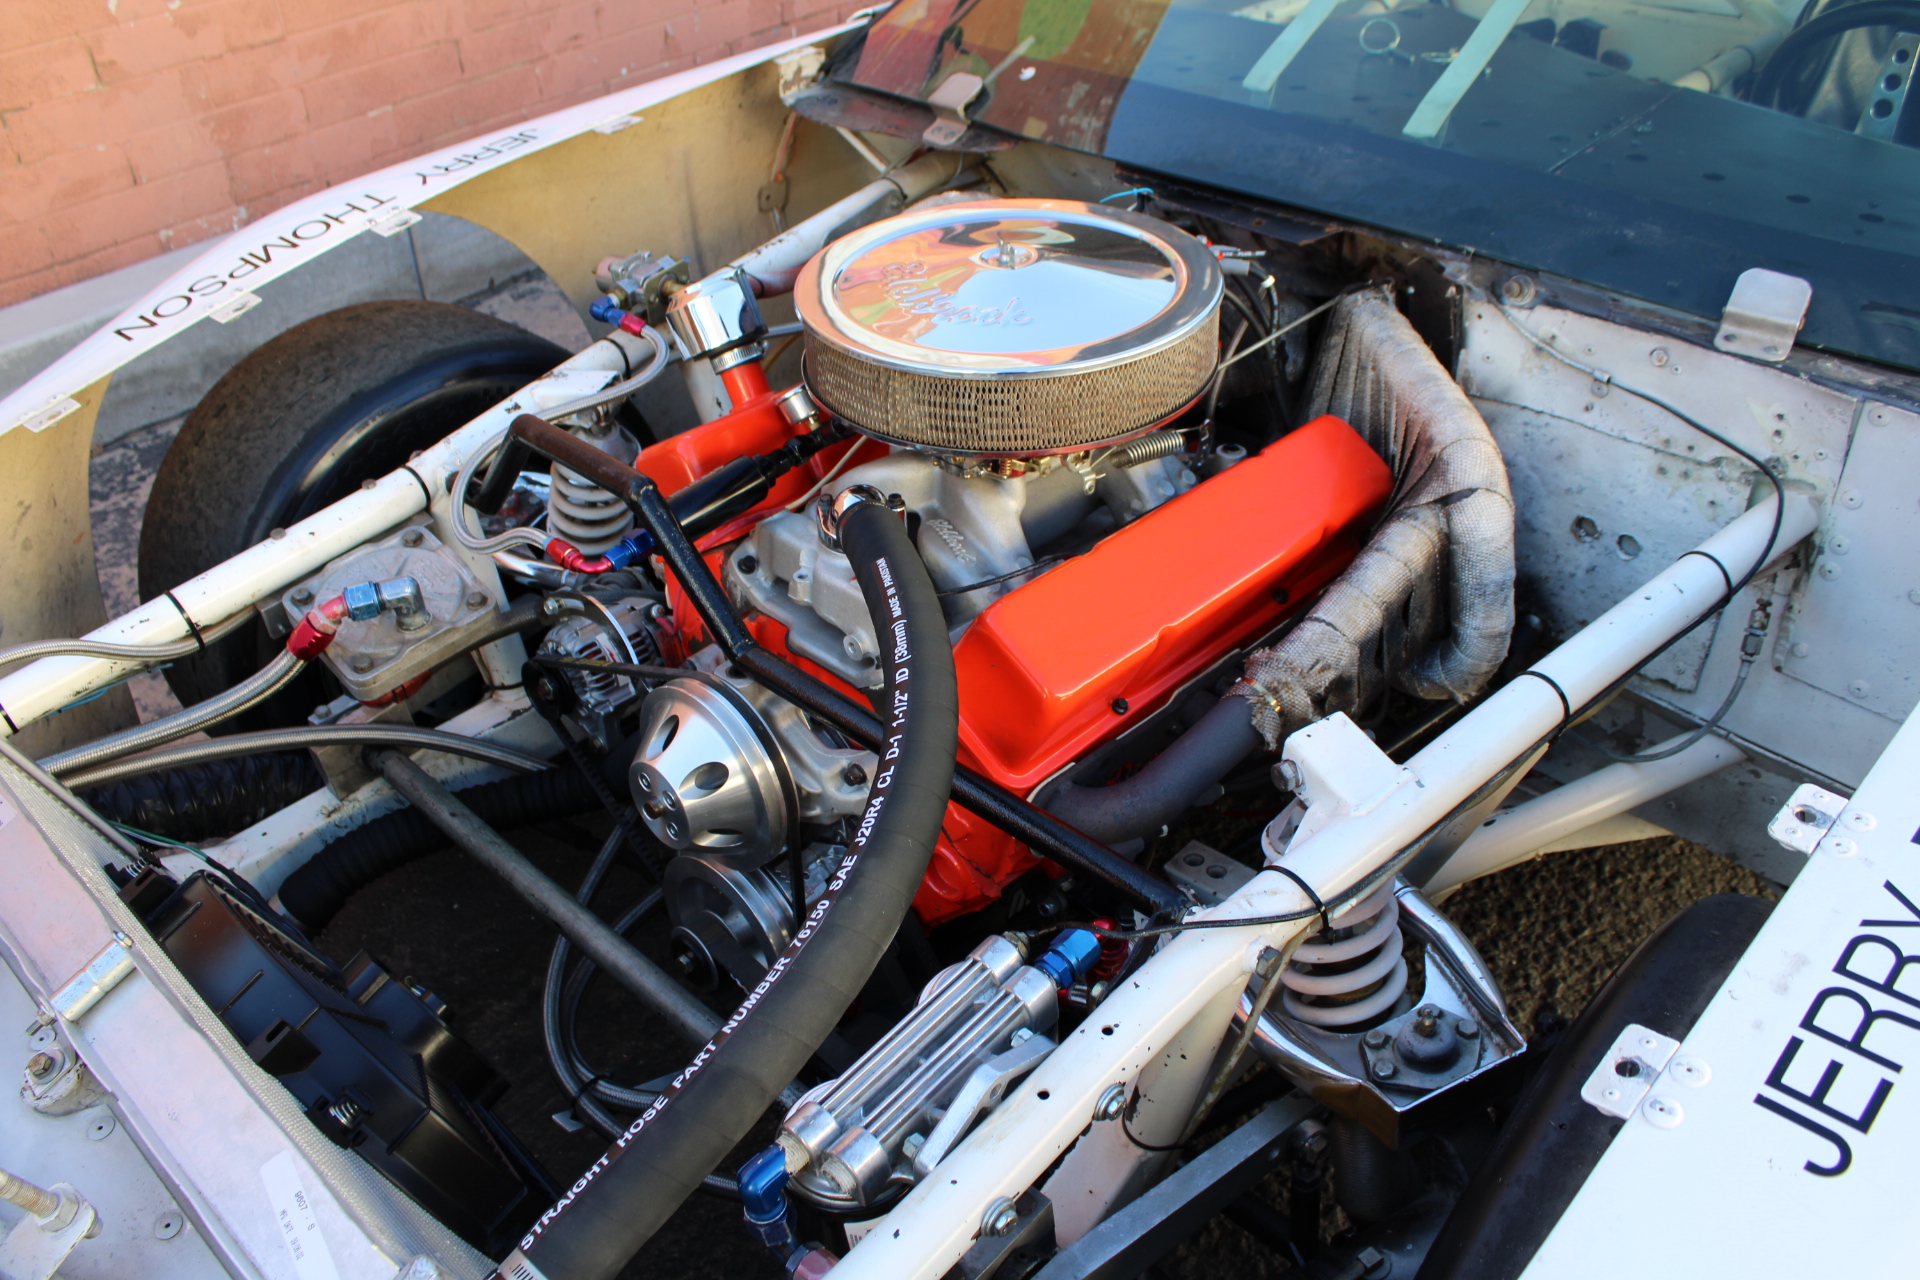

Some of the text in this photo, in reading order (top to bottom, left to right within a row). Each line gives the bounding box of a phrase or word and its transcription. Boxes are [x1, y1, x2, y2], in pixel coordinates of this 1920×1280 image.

[113, 128, 539, 342] JERRY THOMPSON
[520, 557, 912, 1250] STRAIGHT HOSE PART NUMBER 76150 SAE J20R4 CL D-1 1-1/2" ID (38mm) MADE IN PAKISTAN
[307, 1222, 315, 1231] S
